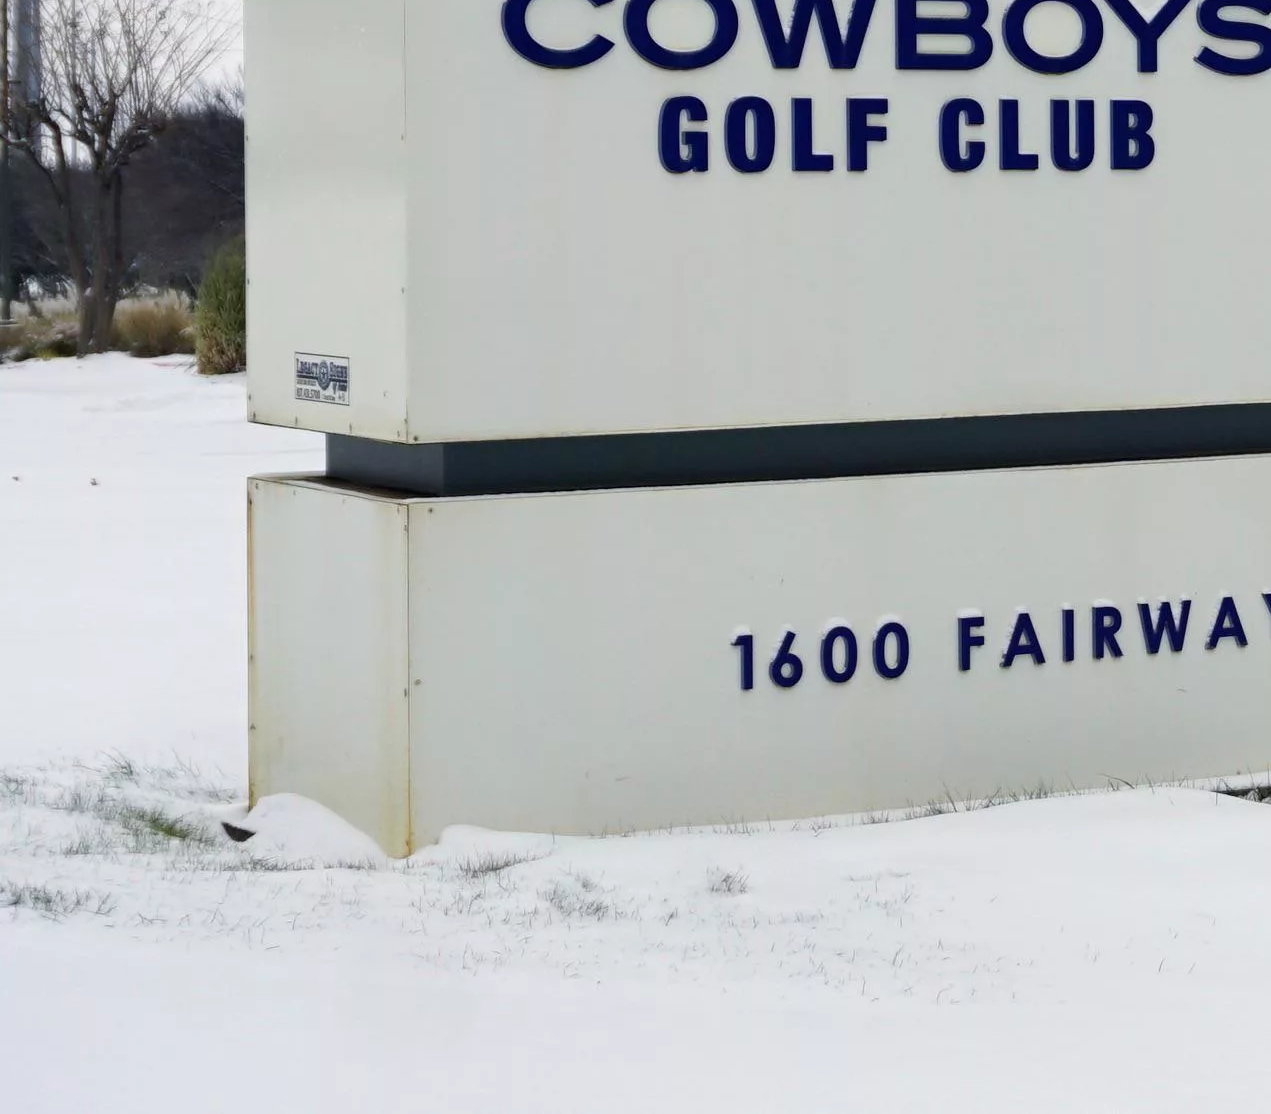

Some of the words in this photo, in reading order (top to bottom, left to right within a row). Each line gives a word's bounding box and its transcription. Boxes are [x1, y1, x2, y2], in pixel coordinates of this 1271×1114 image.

[657, 95, 889, 175] GOLF
[938, 97, 1156, 174] CLUB
[730, 621, 910, 692] 1600
